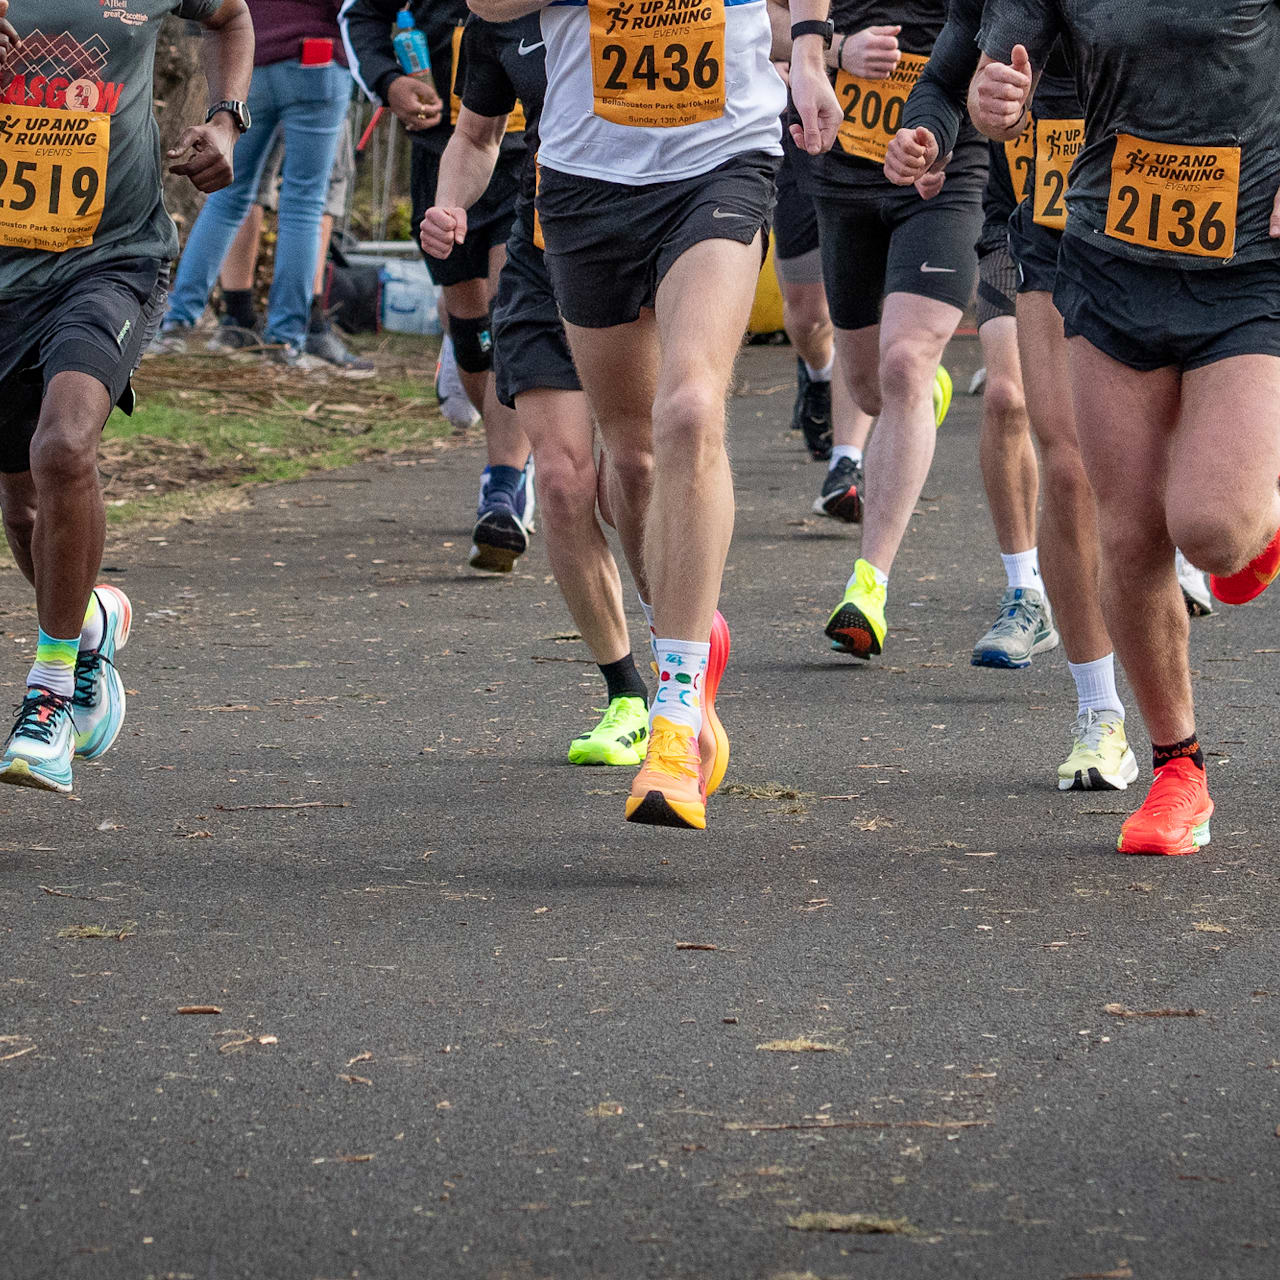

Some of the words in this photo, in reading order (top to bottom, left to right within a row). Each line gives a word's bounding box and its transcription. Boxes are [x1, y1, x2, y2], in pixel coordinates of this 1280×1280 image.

[640, 0, 664, 14] UP
[631, 7, 712, 30] RUNNING
[653, 26, 690, 38] EVENTS
[602, 40, 719, 92] 2436
[602, 98, 653, 109] Bellahouston
[655, 102, 674, 110] Park
[26, 118, 49, 131] UP
[49, 118, 89, 131] AND
[628, 115, 658, 124] Sunday
[677, 114, 697, 124] April
[15, 132, 97, 146] RUNNING
[1065, 129, 1081, 142] UP
[35, 148, 73, 156] EVENTS
[1154, 153, 1178, 166] UP
[1179, 154, 1217, 167] AND
[1146, 165, 1225, 182] RUNNING
[1164, 181, 1200, 192] EVENTS
[1114, 185, 1226, 251] 2136
[29, 224, 48, 232] Park
[3, 234, 32, 245] Sunday
